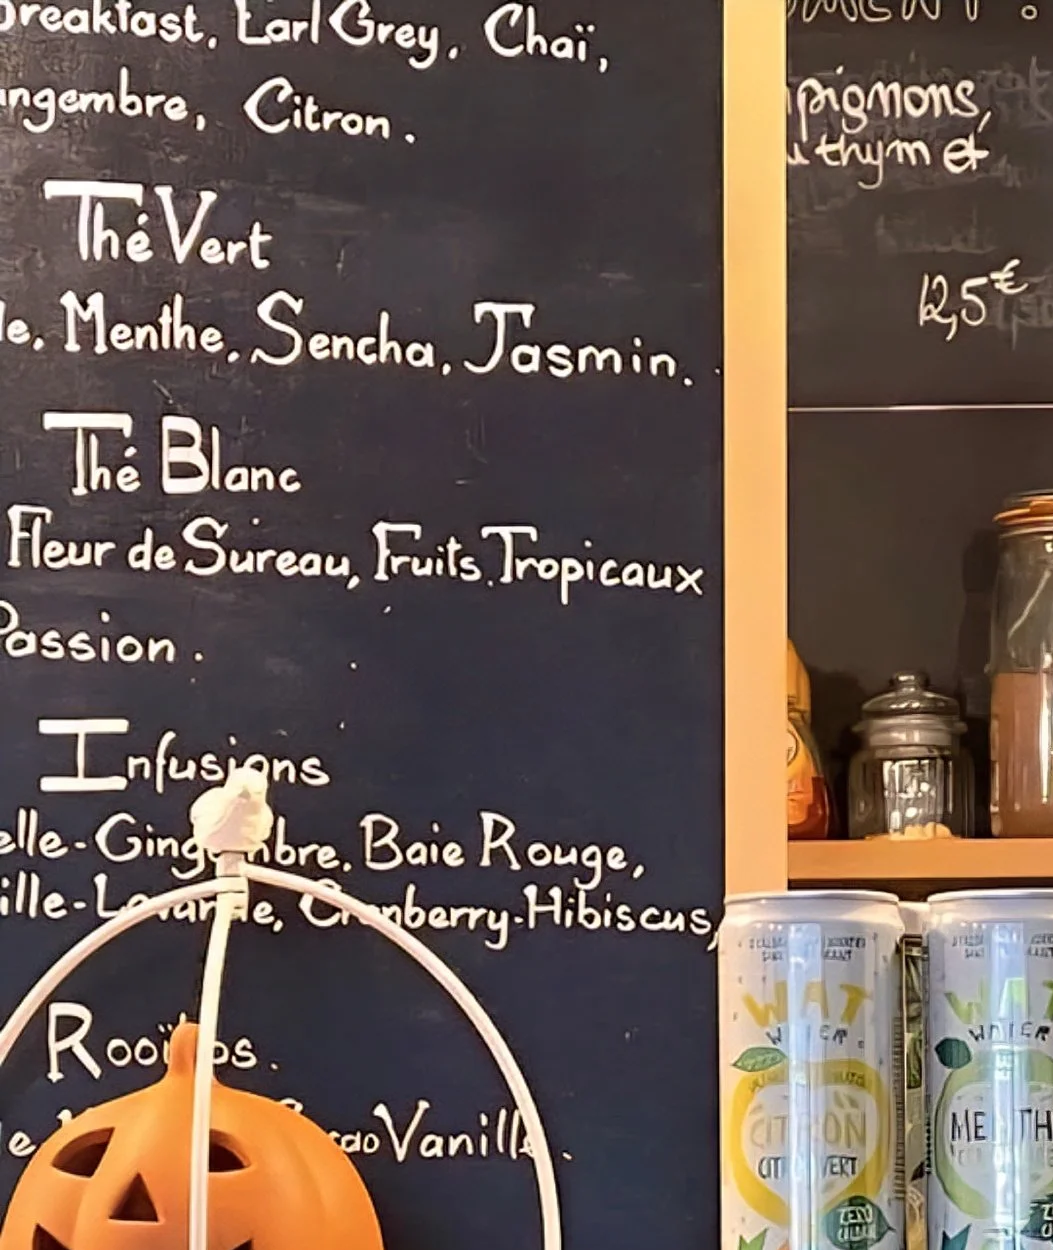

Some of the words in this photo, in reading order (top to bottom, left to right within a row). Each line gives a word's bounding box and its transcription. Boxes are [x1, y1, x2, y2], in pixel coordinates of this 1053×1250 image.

[483, 2, 610, 73] Chaï,
[0, 66, 206, 133] ngembre,
[787, 66, 992, 143] pignons,
[815, 133, 931, 190] thym
[943, 132, 990, 174] et
[43, 180, 154, 263] Thé
[155, 185, 273, 270] Vert
[43, 412, 142, 496] Thé
[161, 414, 302, 494] Blanc
[6, 504, 115, 570] Fleur
[127, 527, 177, 570] de
[183, 517, 361, 590] Sureau,
[481, 525, 704, 602] Tropicaux
[38, 718, 331, 793] Infusions
[360, 815, 466, 870] Baie
[480, 812, 645, 892] Rouge,
[298, 877, 720, 952] Crnberry-Hibiscus,
[765, 1020, 849, 1046] WER
[750, 1111, 867, 1150] CITON
